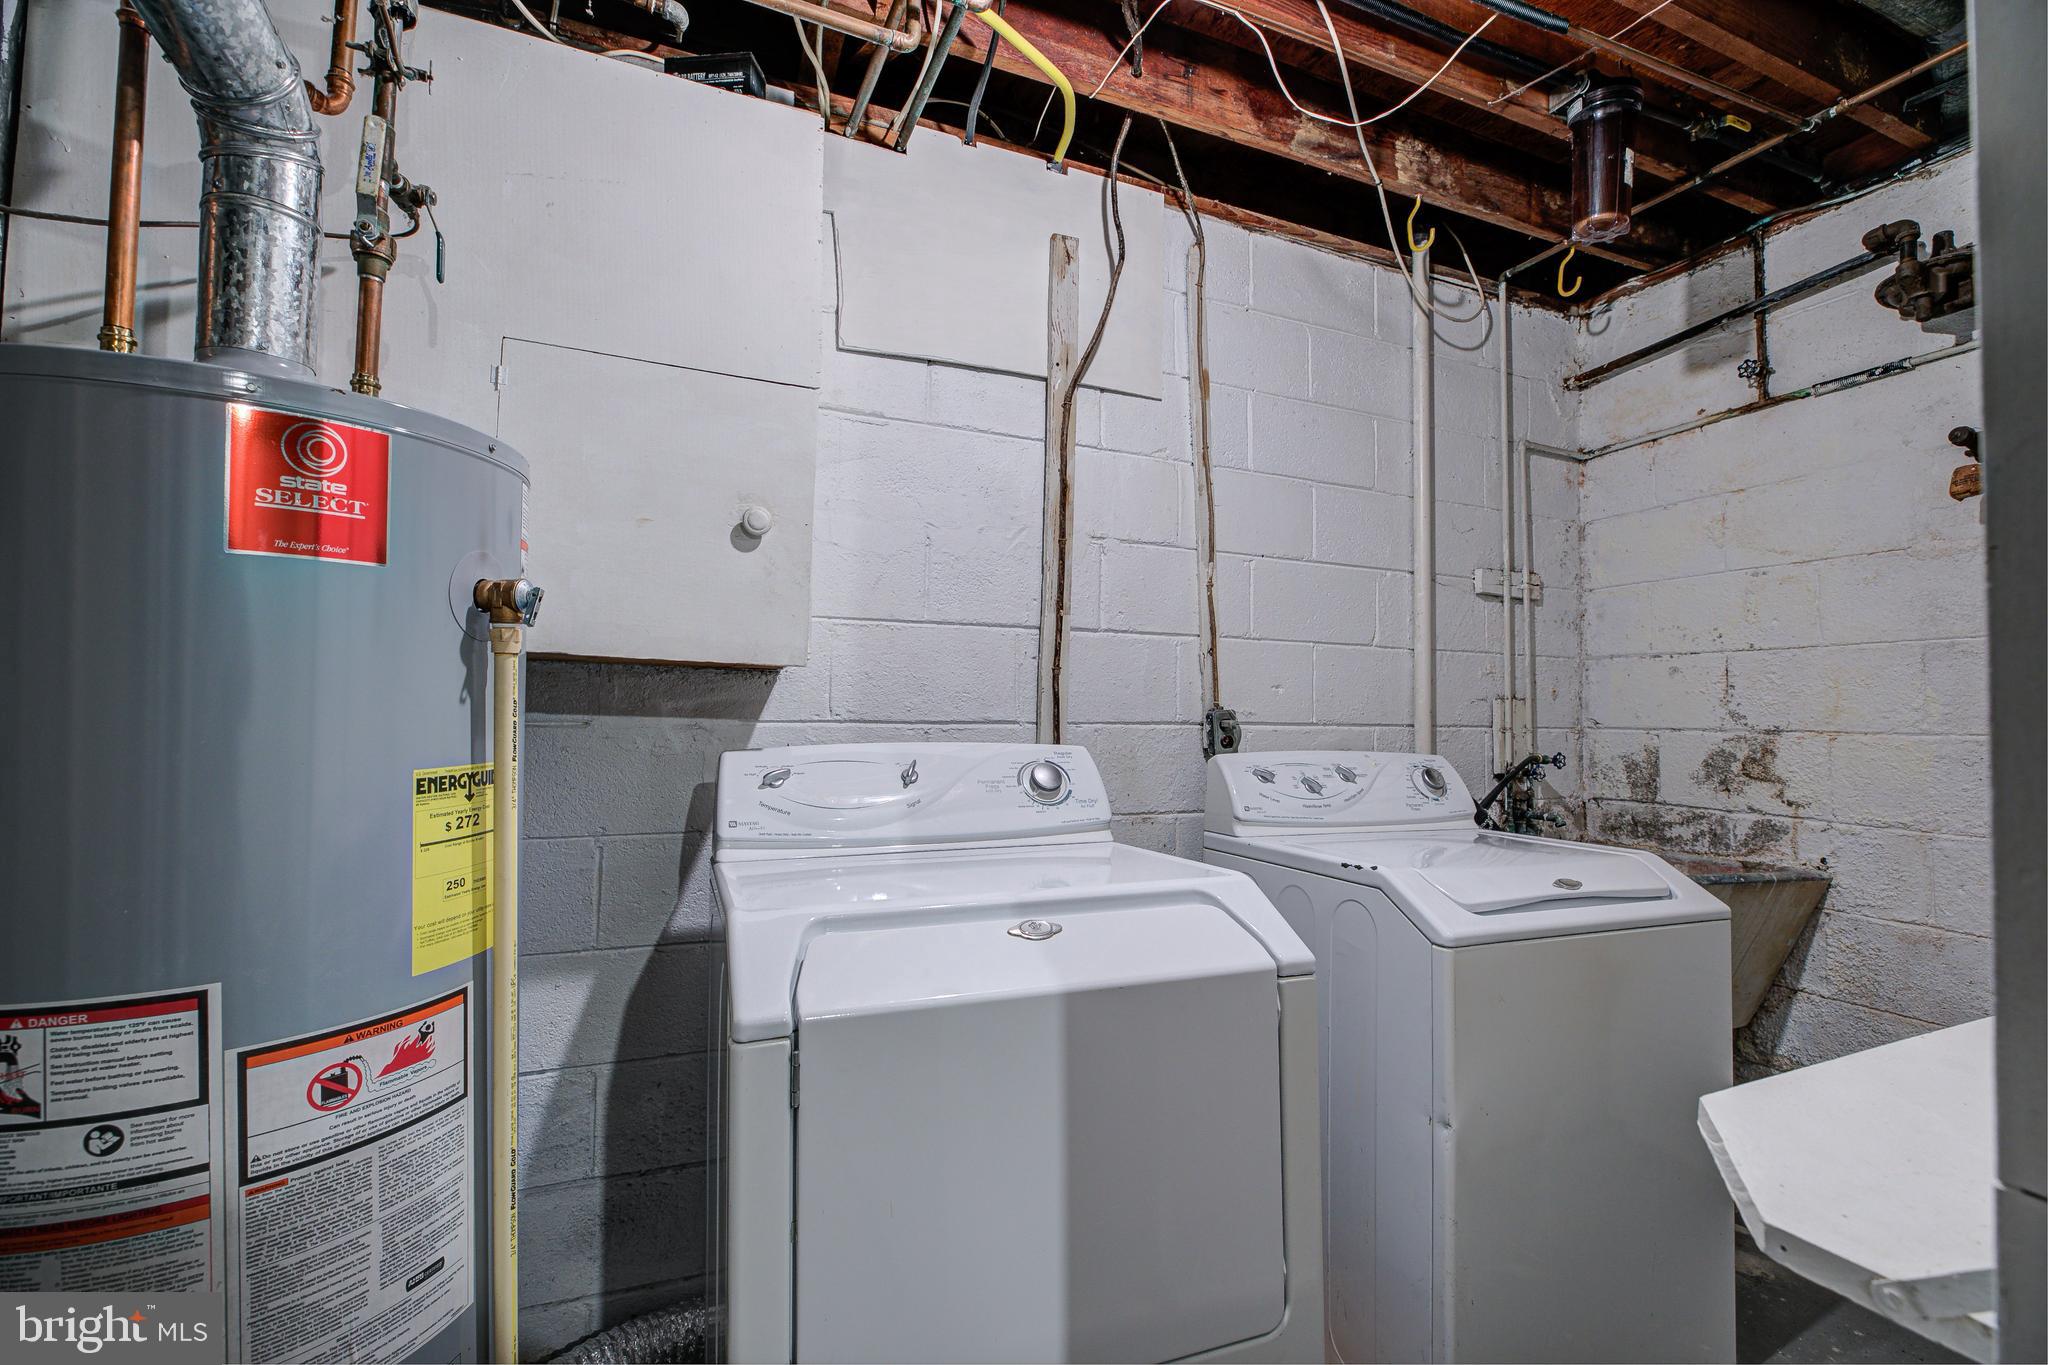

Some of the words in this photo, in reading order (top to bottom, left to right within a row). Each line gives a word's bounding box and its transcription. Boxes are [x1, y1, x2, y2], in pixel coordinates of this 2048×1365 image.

[279, 475, 348, 495] state
[255, 487, 367, 514] SELECT
[273, 539, 288, 548] The
[290, 541, 320, 551] Expert's
[321, 544, 346, 553] Choice
[759, 800, 791, 816] Temperature
[906, 798, 921, 809] Signal
[430, 810, 454, 819] Estimated
[445, 821, 452, 832] $
[456, 813, 480, 830] 272
[446, 877, 466, 892] 250
[27, 1014, 88, 1028] DANGER
[356, 1019, 404, 1040] WARNING
[379, 1073, 408, 1087] Flammable
[410, 1064, 428, 1075] Vapors
[335, 1111, 348, 1119] FIRE
[349, 1107, 361, 1115] AND
[362, 1097, 391, 1110] EXPLOSION
[391, 1088, 411, 1099] HAZARD
[341, 1117, 357, 1126] result
[364, 1109, 382, 1118] serious
[383, 1103, 397, 1111] injury
[130, 1125, 165, 1134] information
[166, 1121, 184, 1129] about
[290, 1172, 312, 1183] Protect
[313, 1165, 334, 1176] against
